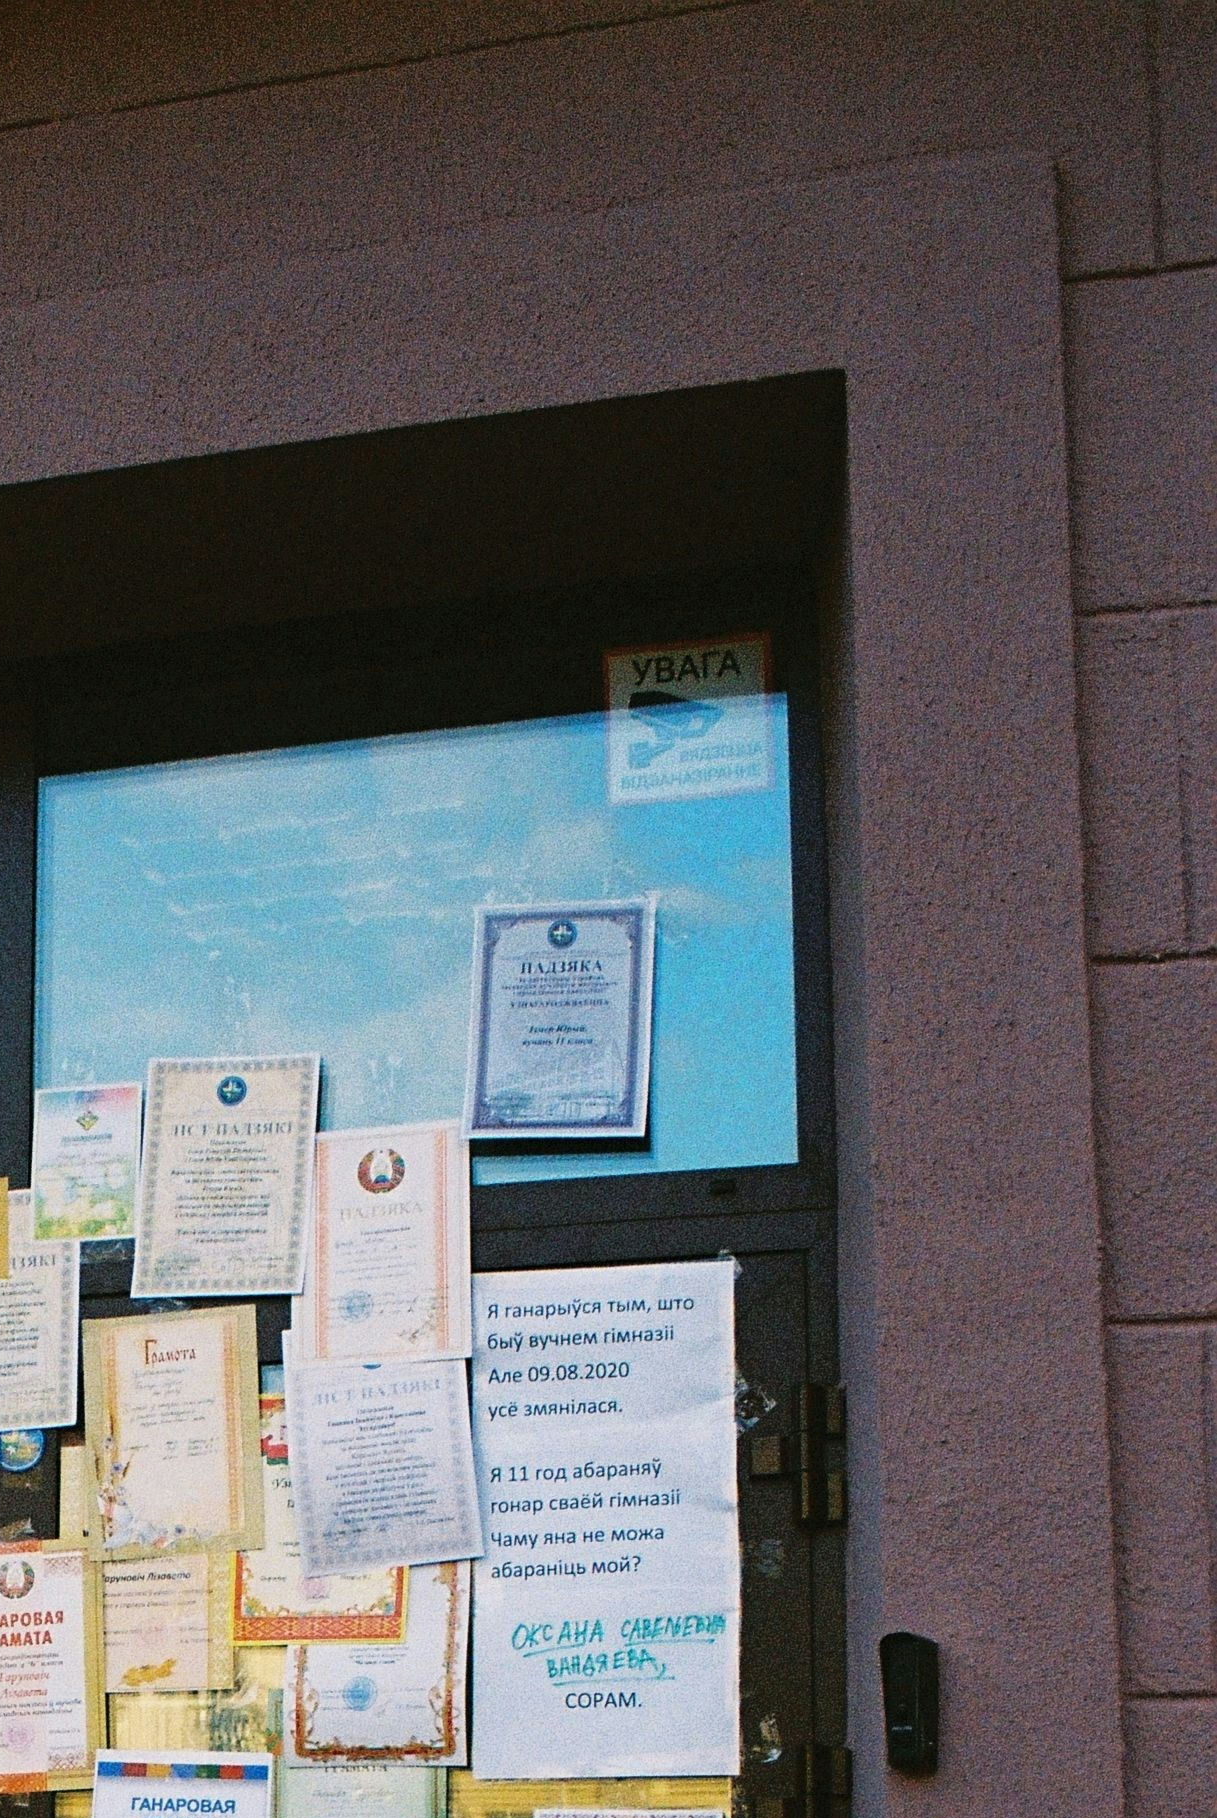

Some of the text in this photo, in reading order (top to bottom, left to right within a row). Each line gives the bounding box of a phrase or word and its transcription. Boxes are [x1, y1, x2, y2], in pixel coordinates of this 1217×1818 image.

[631, 650, 741, 687] УВАГА
[520, 960, 603, 975] ПАДЗЯКА
[487, 1297, 694, 1322] Я ганарыўся тым, што
[487, 1326, 674, 1353] быў вучнем гімназіі
[488, 1361, 630, 1385] Але 09.08.2020
[487, 1399, 623, 1421] усё змянілася.
[490, 1460, 662, 1484] Я 11 год абараняў
[490, 1490, 681, 1517] гонар сваёй гімназіі
[490, 1527, 665, 1551] Чаму яна не можа
[490, 1554, 641, 1581] абараніць мой?
[511, 1618, 605, 1651] ОКСАНА
[564, 1691, 643, 1709] СОРАМ.
[131, 1796, 236, 1814] ГАНАРОВАЯ
